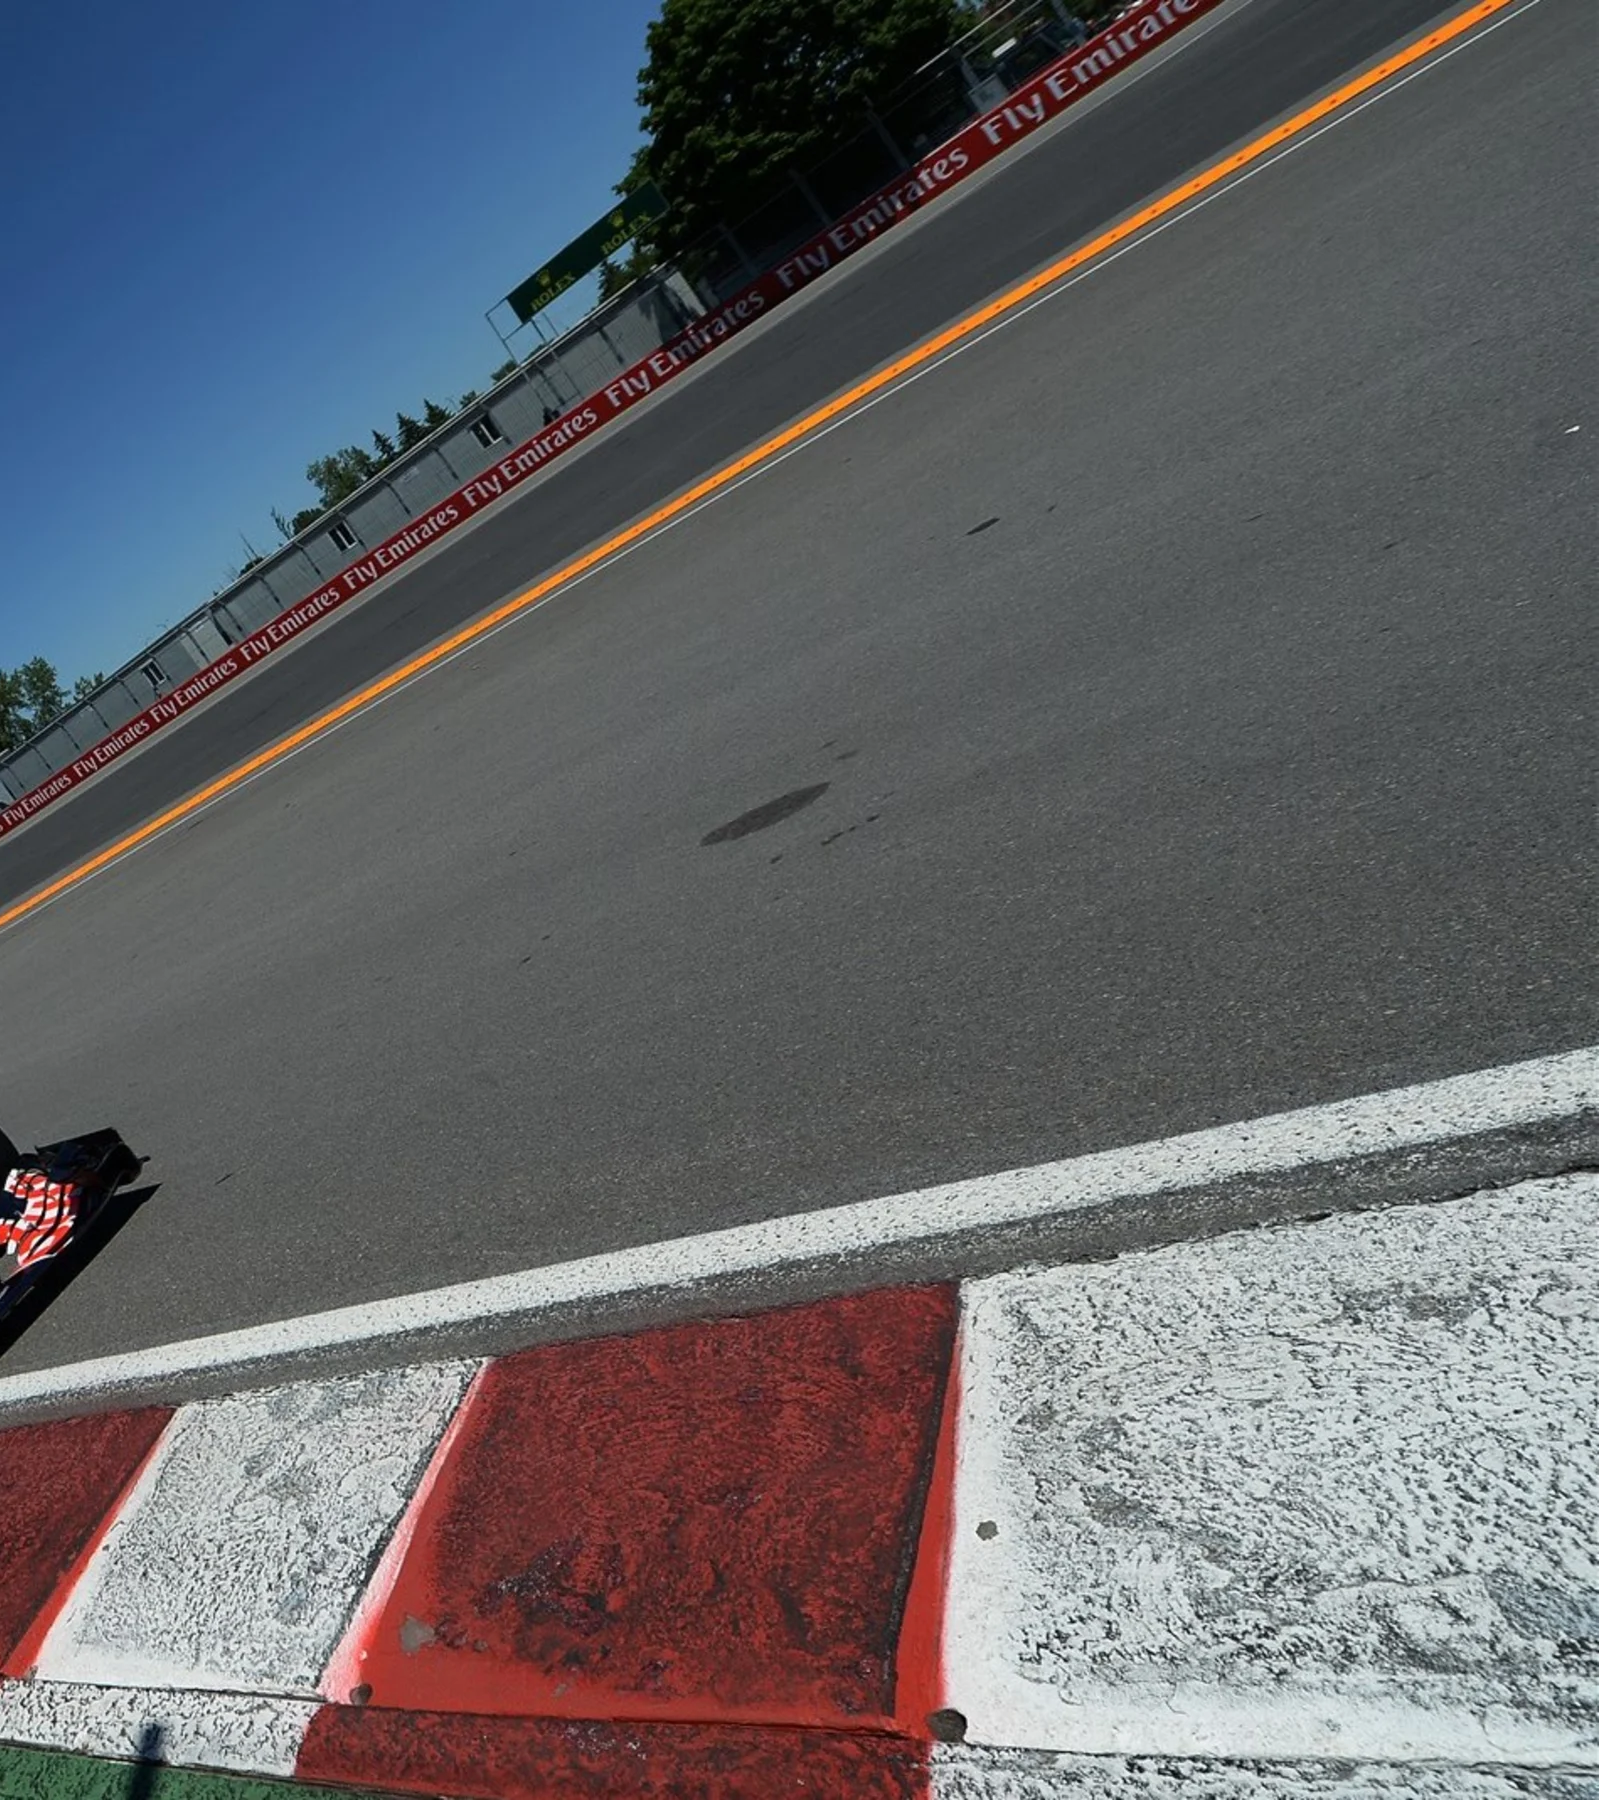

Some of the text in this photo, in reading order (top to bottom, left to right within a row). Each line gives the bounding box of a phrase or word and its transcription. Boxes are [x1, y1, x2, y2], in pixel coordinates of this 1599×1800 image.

[980, 0, 1200, 145] Fly Emirate
[775, 147, 969, 289] Fly Emirates
[603, 290, 765, 407] Fly Emirates
[461, 407, 598, 507] Fly Emirates
[342, 504, 459, 590] Fly Emirates
[239, 586, 340, 661] Fly Emirates
[149, 658, 238, 723] Fly Emirates
[72, 718, 150, 777] Fly Emirates
[2, 773, 73, 826] Fly Emirates
